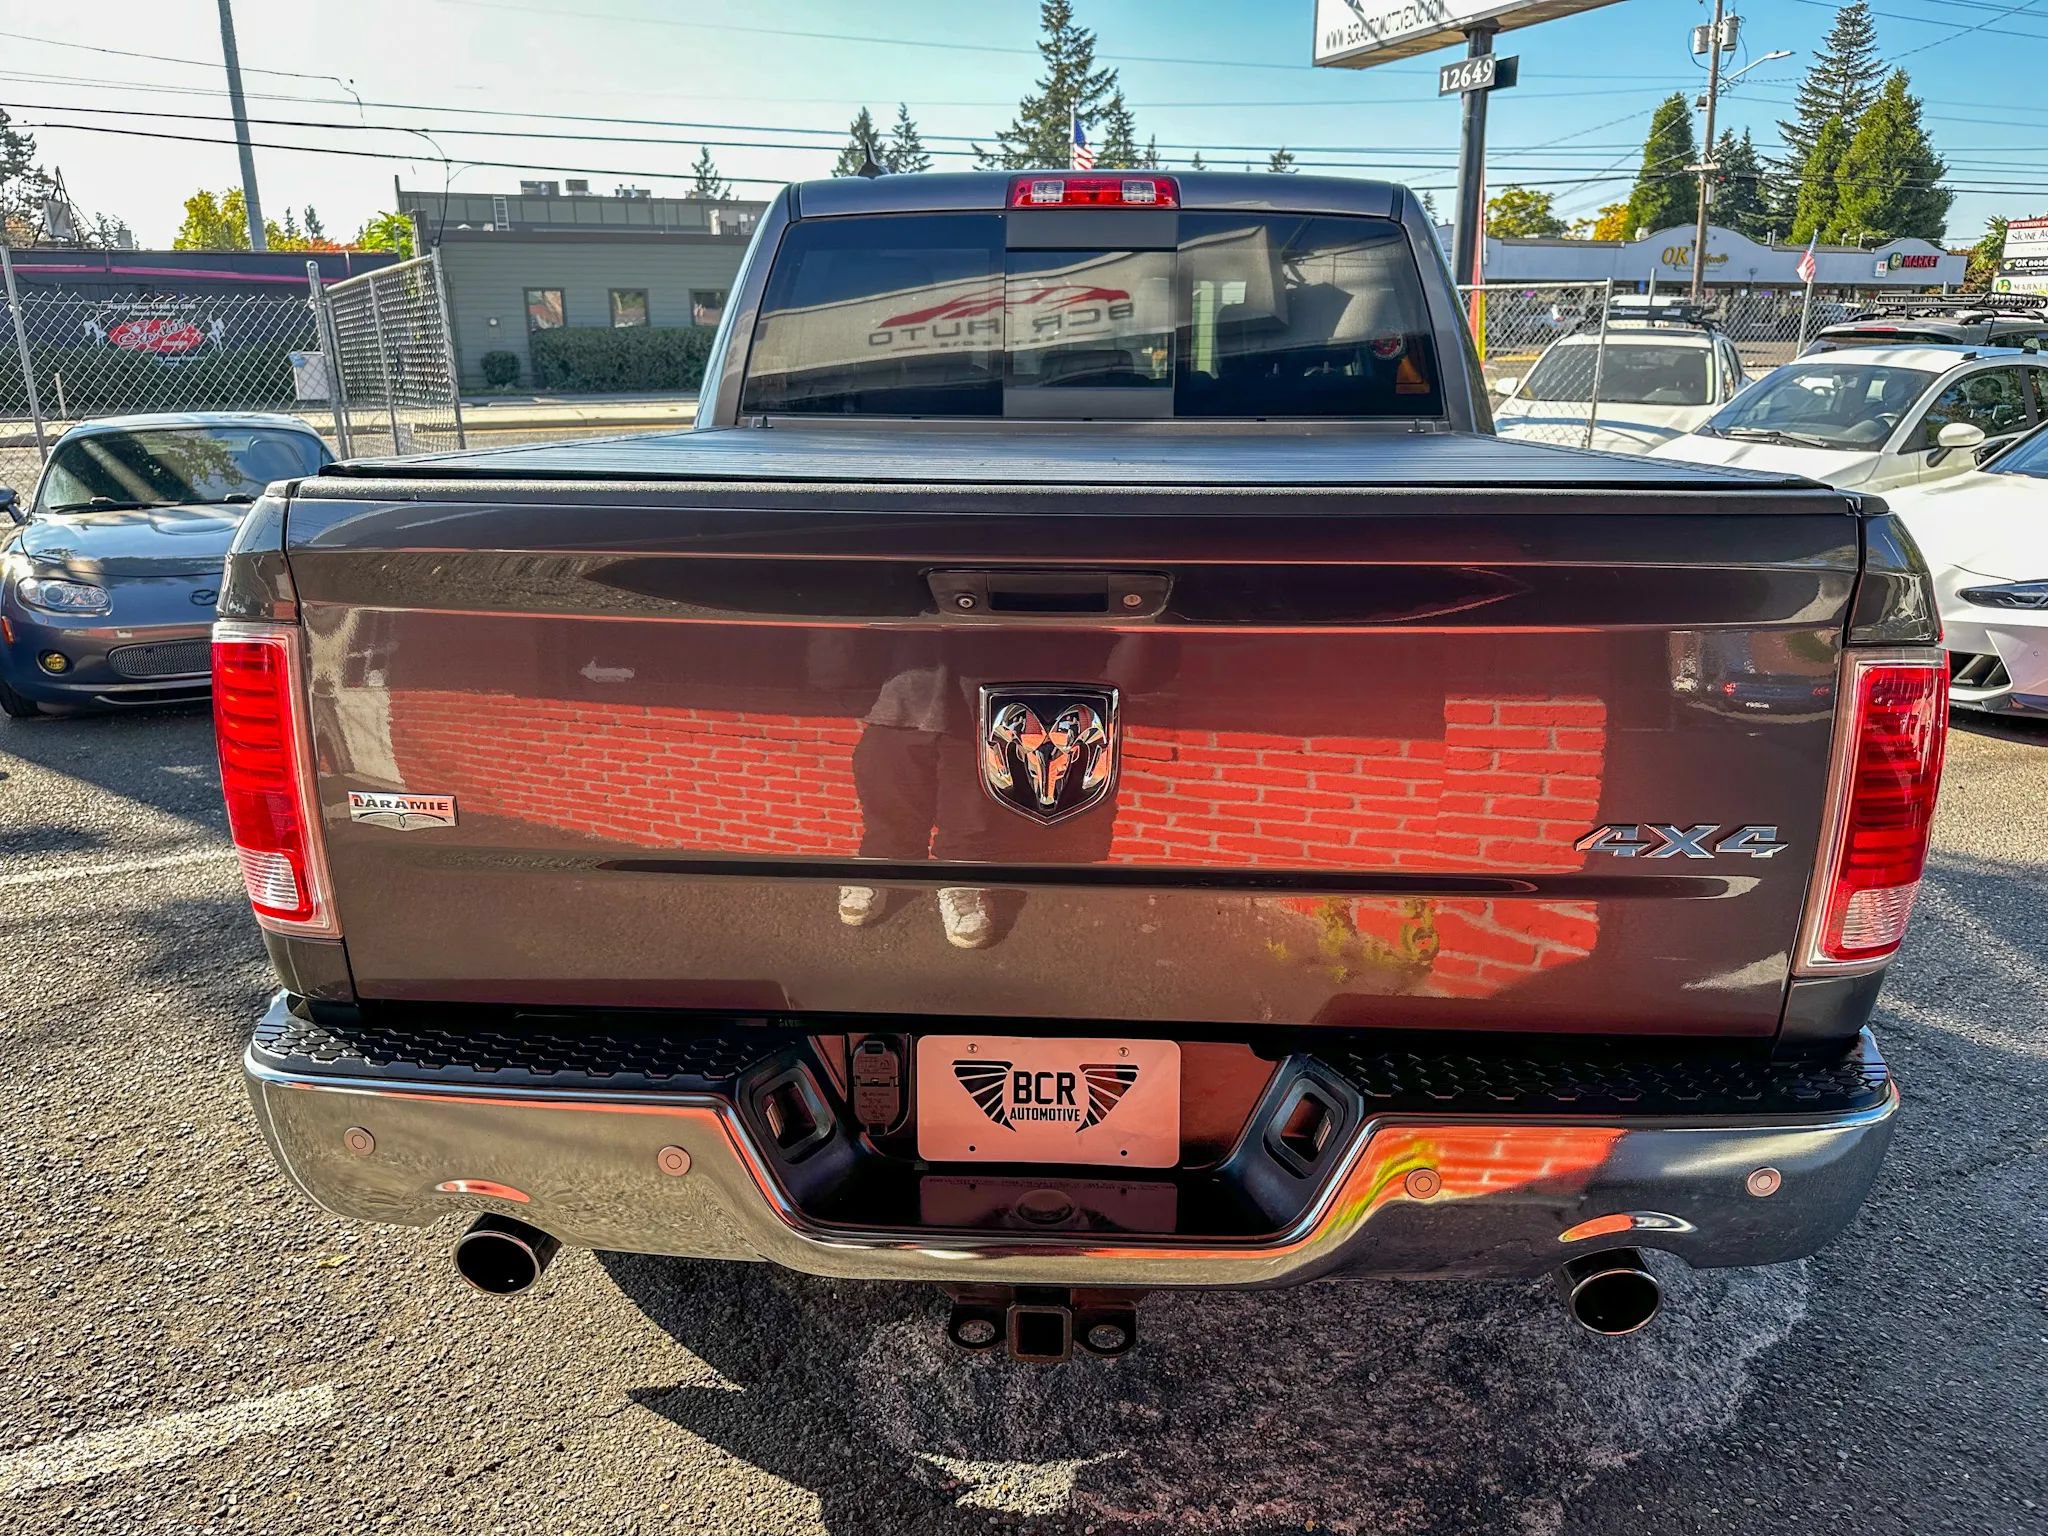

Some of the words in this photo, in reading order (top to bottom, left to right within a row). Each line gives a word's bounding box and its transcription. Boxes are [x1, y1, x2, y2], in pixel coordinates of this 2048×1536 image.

[1440, 58, 1493, 92] 12649
[1662, 246, 1688, 265] OK
[354, 797, 449, 811] LARAMIE
[1013, 1071, 1076, 1107] BCR
[1009, 1107, 1081, 1122] AUTOMOTIVE
